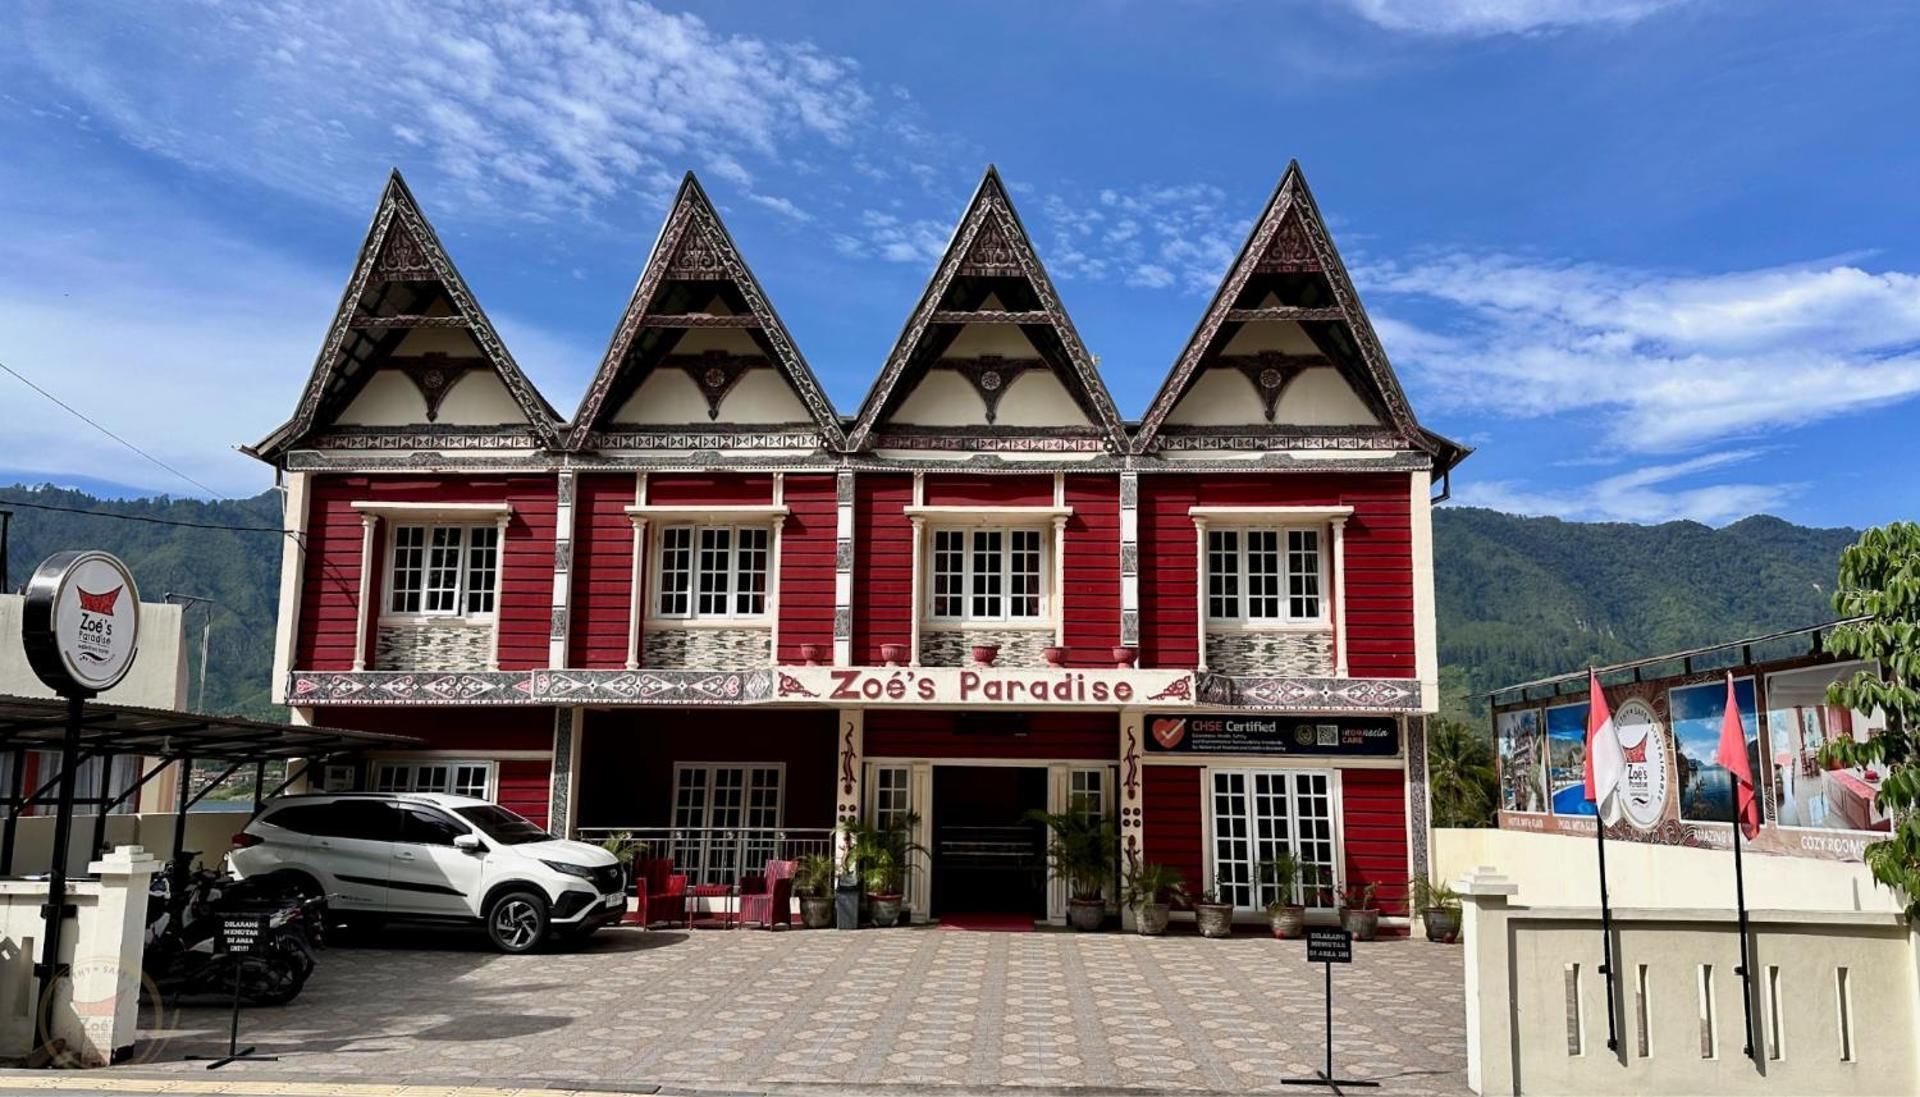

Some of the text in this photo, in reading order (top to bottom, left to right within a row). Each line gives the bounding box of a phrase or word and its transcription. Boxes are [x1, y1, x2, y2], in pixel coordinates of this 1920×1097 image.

[80, 613, 112, 636] Zoé's
[829, 670, 1134, 702] Zoé's Paradise
[1192, 720, 1276, 733] CHSE Certified
[1801, 835, 1826, 851] COZY
